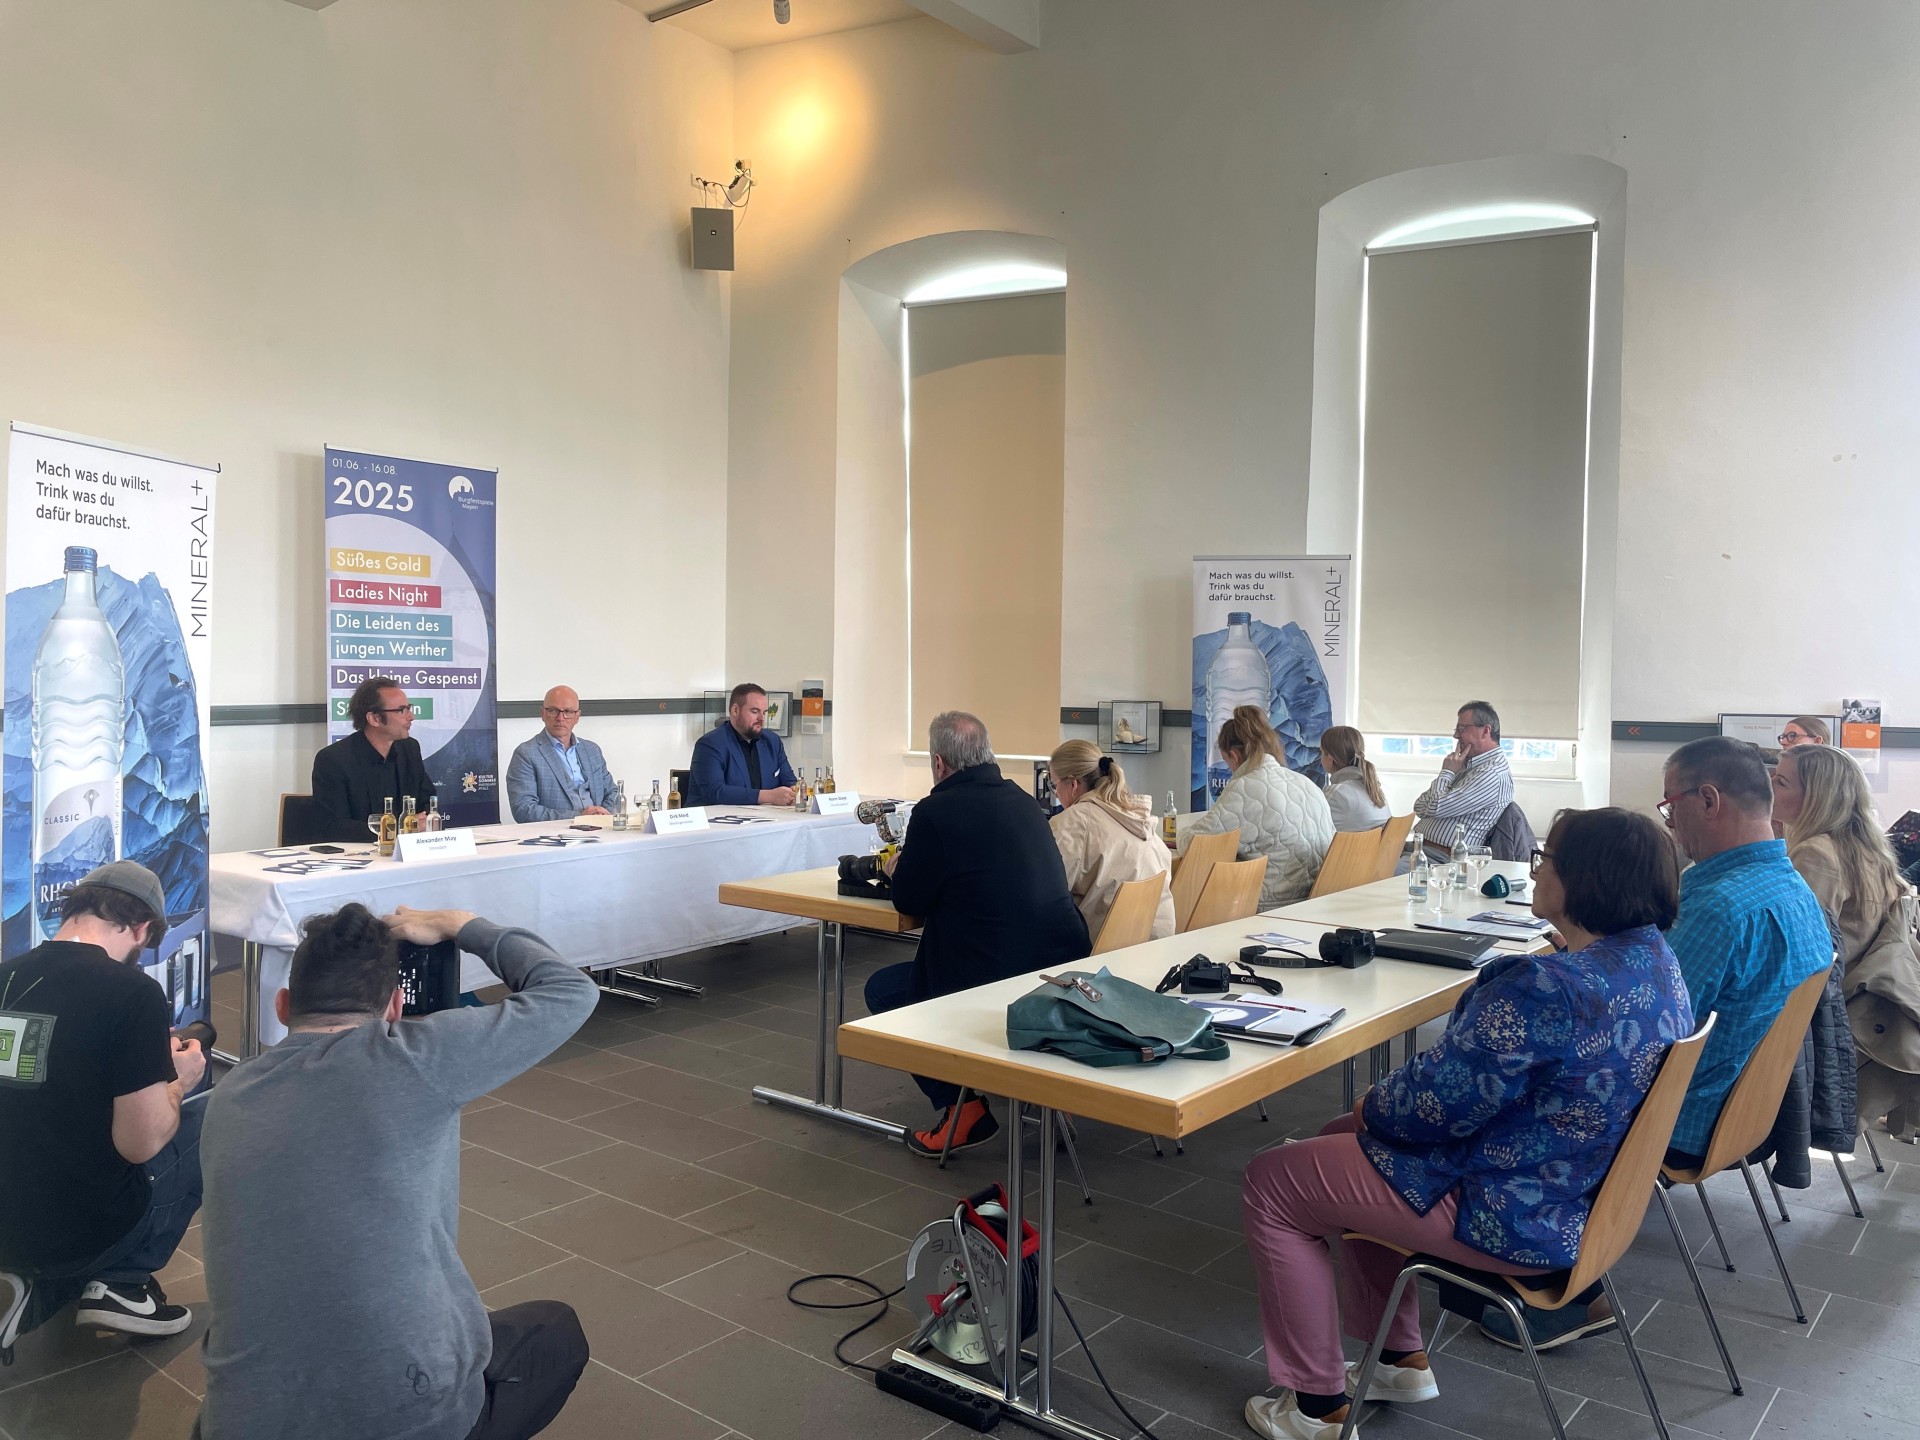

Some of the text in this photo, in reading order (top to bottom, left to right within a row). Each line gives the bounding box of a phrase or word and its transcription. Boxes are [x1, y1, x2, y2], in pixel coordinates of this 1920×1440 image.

[332, 458, 361, 471] 01.06.
[36, 459, 154, 492] Mach was du willst.
[36, 482, 115, 507] Trink was du
[333, 476, 414, 512] 2025
[36, 504, 131, 530] dafür brauchst.
[336, 551, 421, 572] Süßes Gold
[1209, 570, 1295, 580] Mach was du willst.
[338, 583, 428, 605] Ladies Night
[1209, 582, 1231, 591] Trink
[1252, 581, 1265, 590] du
[1208, 592, 1276, 602] dafür brauchst.
[336, 614, 440, 632] Die Leiden des
[335, 640, 447, 659] jungen Werther
[336, 669, 364, 684] Das
[415, 671, 478, 688] Gespenst
[44, 813, 80, 825] CLASSIC
